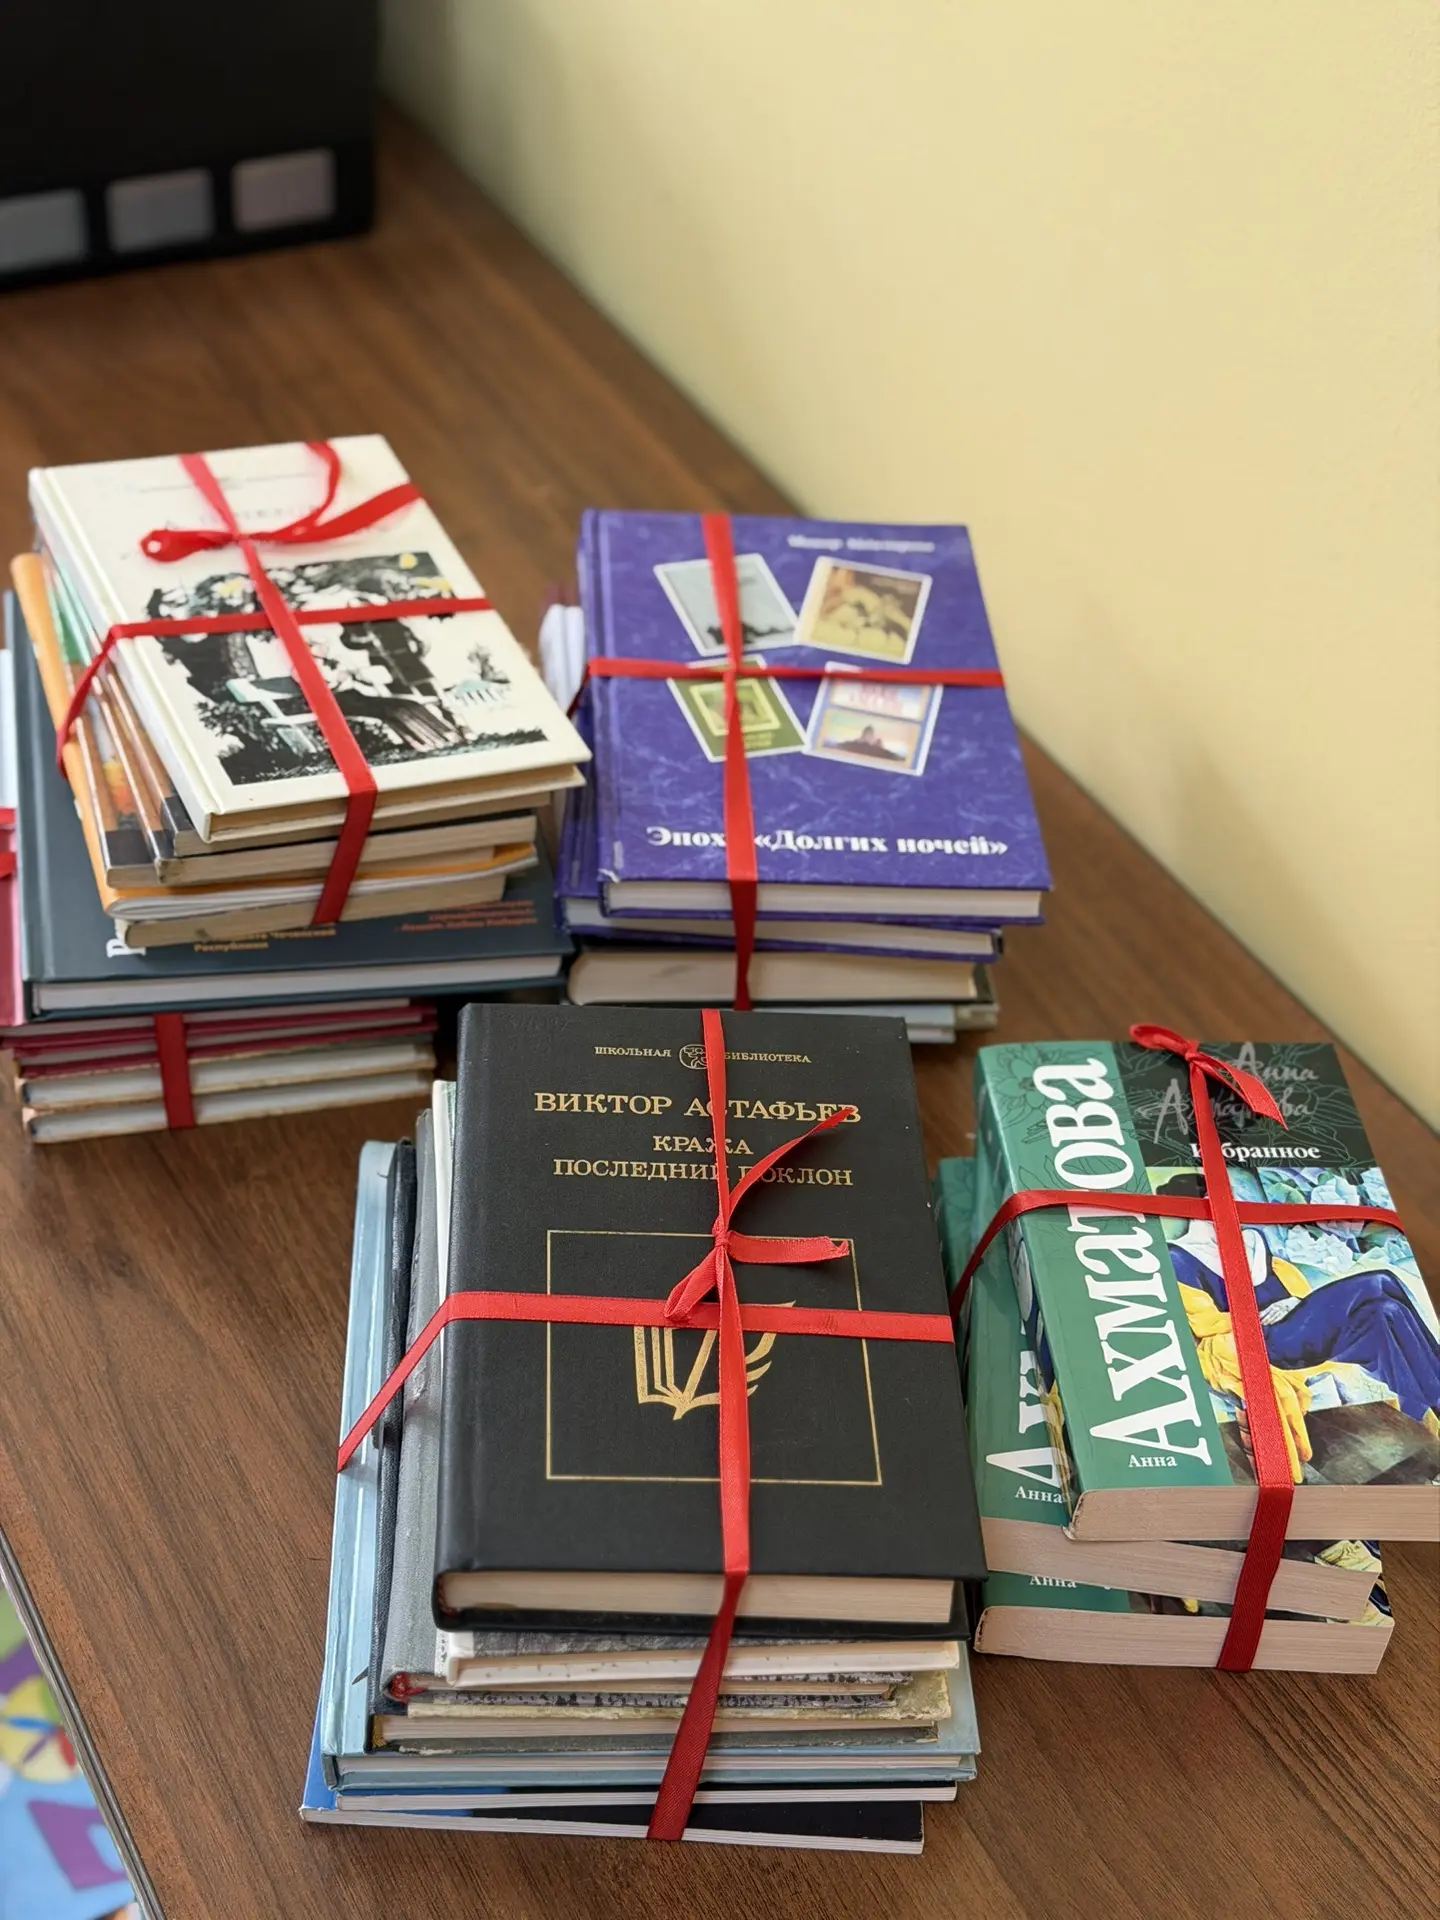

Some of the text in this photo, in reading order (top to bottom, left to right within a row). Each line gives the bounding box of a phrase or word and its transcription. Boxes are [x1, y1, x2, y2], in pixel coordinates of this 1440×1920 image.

[646, 827, 1008, 855] Эпох «Долгих ночей»
[594, 1046, 812, 1063] ШКОЛЬНАЯ БИБЛИОТЕКА
[534, 1092, 673, 1116] ВИКТОР
[1189, 1142, 1321, 1162] бранное
[1033, 1057, 1213, 1467] Ахматова
[1128, 1454, 1177, 1469] Анна
[1014, 1486, 1064, 1504] Анна
